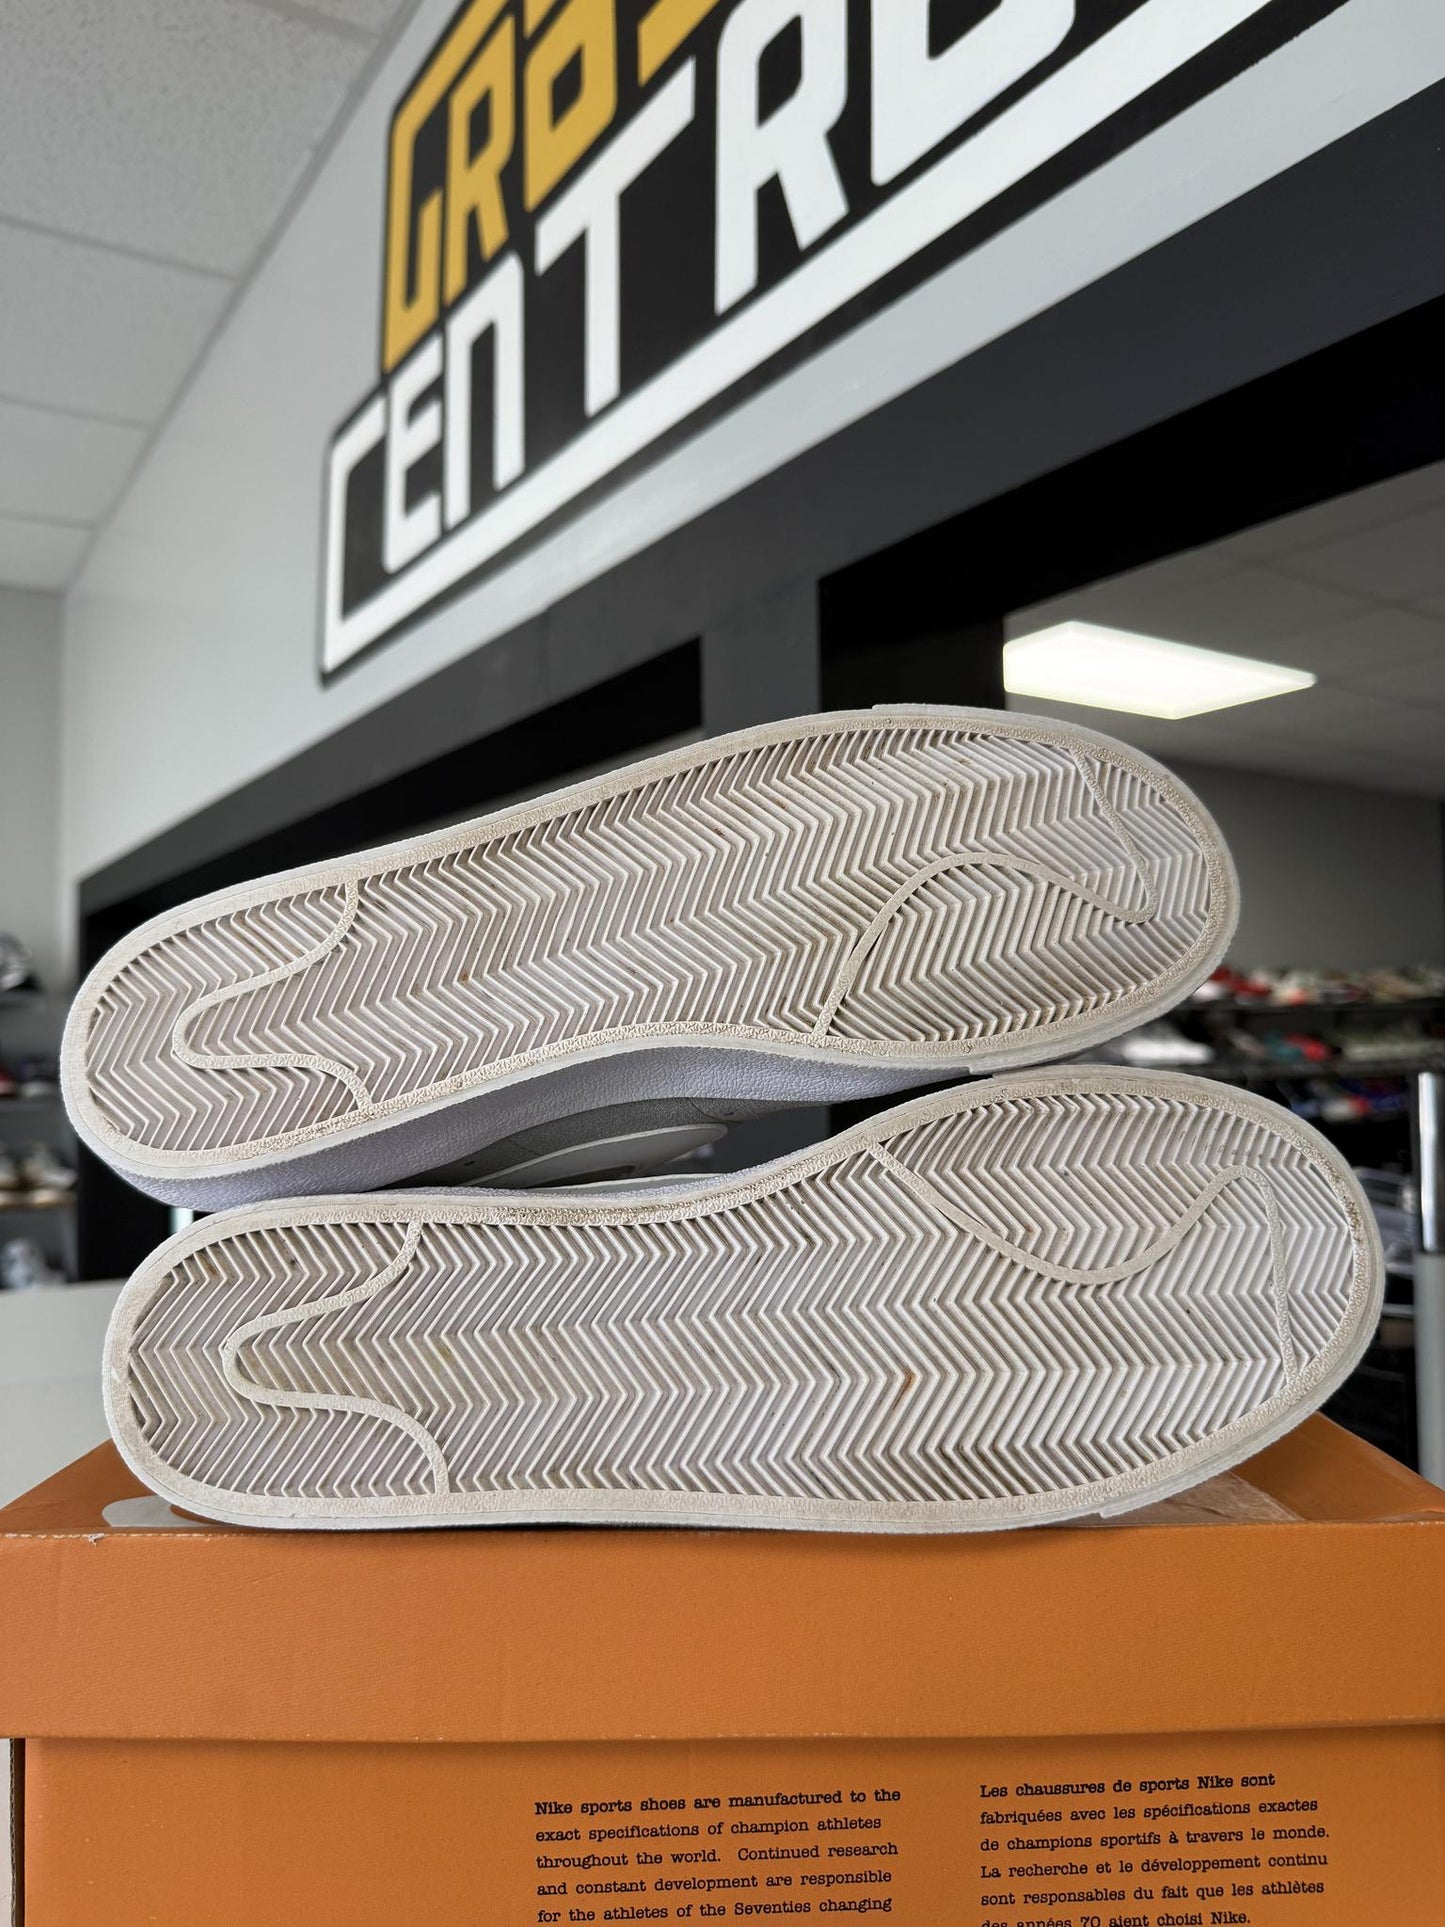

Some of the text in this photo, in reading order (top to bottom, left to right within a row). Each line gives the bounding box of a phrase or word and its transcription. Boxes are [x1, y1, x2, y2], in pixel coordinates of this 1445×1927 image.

[979, 1773, 1276, 1799] Les chaussures de sports Nike sont
[534, 1788, 901, 1816] Nike sports shoes are manufactured to the
[979, 1798, 1318, 1826] fabriquées avec les spécifications exactes
[535, 1816, 882, 1843] exact specifications of champion athletes
[980, 1824, 1330, 1852] de champions sportifs à travers le monde.
[535, 1841, 899, 1870] throughout the world. Continued research
[980, 1853, 1329, 1879] La recherche et le développement continu
[536, 1869, 892, 1896] and constant development are responsible
[980, 1880, 1325, 1906] sont responsables du fait que les athlètes
[537, 1897, 893, 1923] for the athletes of the Seventies changing
[1080, 1915, 1101, 1927] 70
[1108, 1914, 1150, 1927] aient
[1156, 1912, 1203, 1927] choisi
[1210, 1910, 1251, 1925] Nike.
